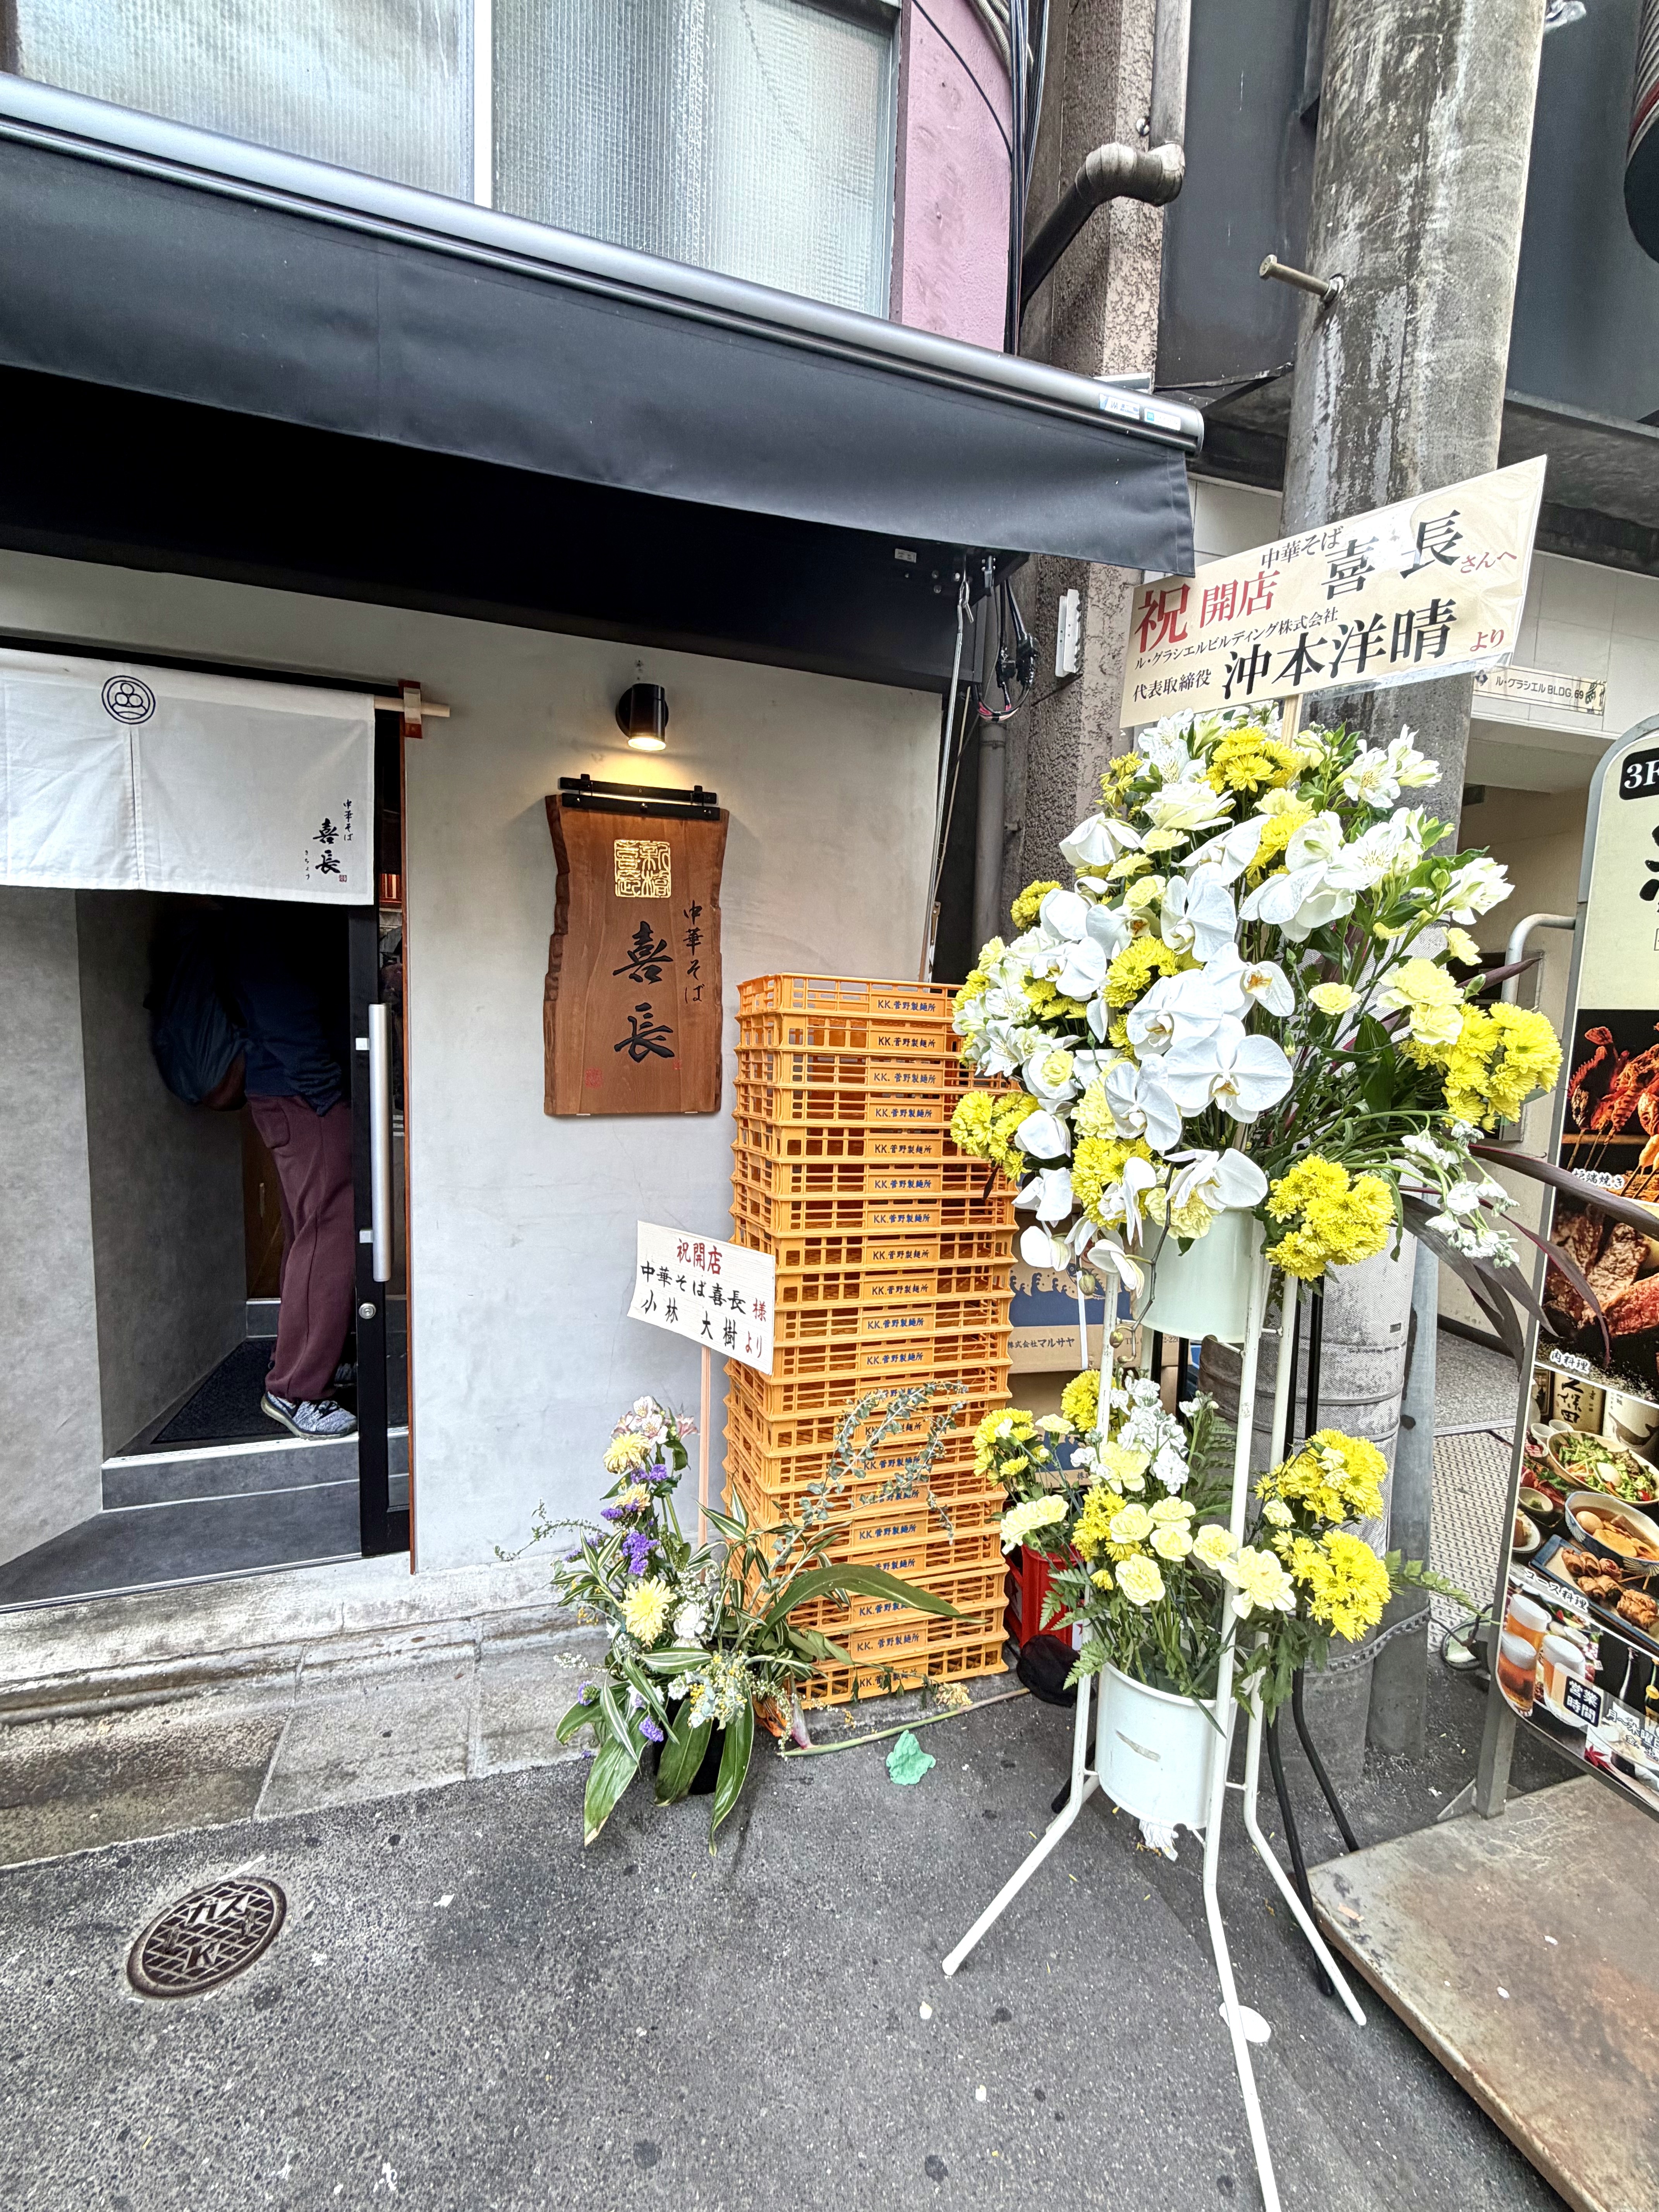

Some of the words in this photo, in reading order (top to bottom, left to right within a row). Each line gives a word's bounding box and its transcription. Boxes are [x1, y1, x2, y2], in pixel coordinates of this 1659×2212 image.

[1262, 526, 1344, 569] 中華そば
[1460, 551, 1517, 573] さんへ
[1134, 584, 1190, 653] 祝
[1200, 570, 1280, 629] 開店
[1132, 668, 1211, 702] 代表取締役
[1222, 598, 1457, 699] 沖本洋晴
[1470, 629, 1504, 652] より
[1135, 606, 1338, 670] ル・グラシエルビルディング株式会社
[1574, 690, 1584, 699] 69
[1624, 760, 1659, 789] 3F
[343, 799, 353, 841] 中華そば
[313, 818, 341, 874] 喜長
[683, 899, 705, 1003] 中華そば
[613, 921, 675, 1063] 喜長
[677, 1238, 722, 1275] 祝開店
[641, 1290, 678, 1323] 小林
[701, 1311, 737, 1350] 大樹
[745, 1331, 762, 1358] より
[752, 1298, 767, 1322] 様
[1552, 1351, 1588, 1370] 肉料理
[1527, 1571, 1586, 1610] コース料理
[1566, 1695, 1595, 1723] 時間
[1569, 1681, 1599, 1708] 営業
